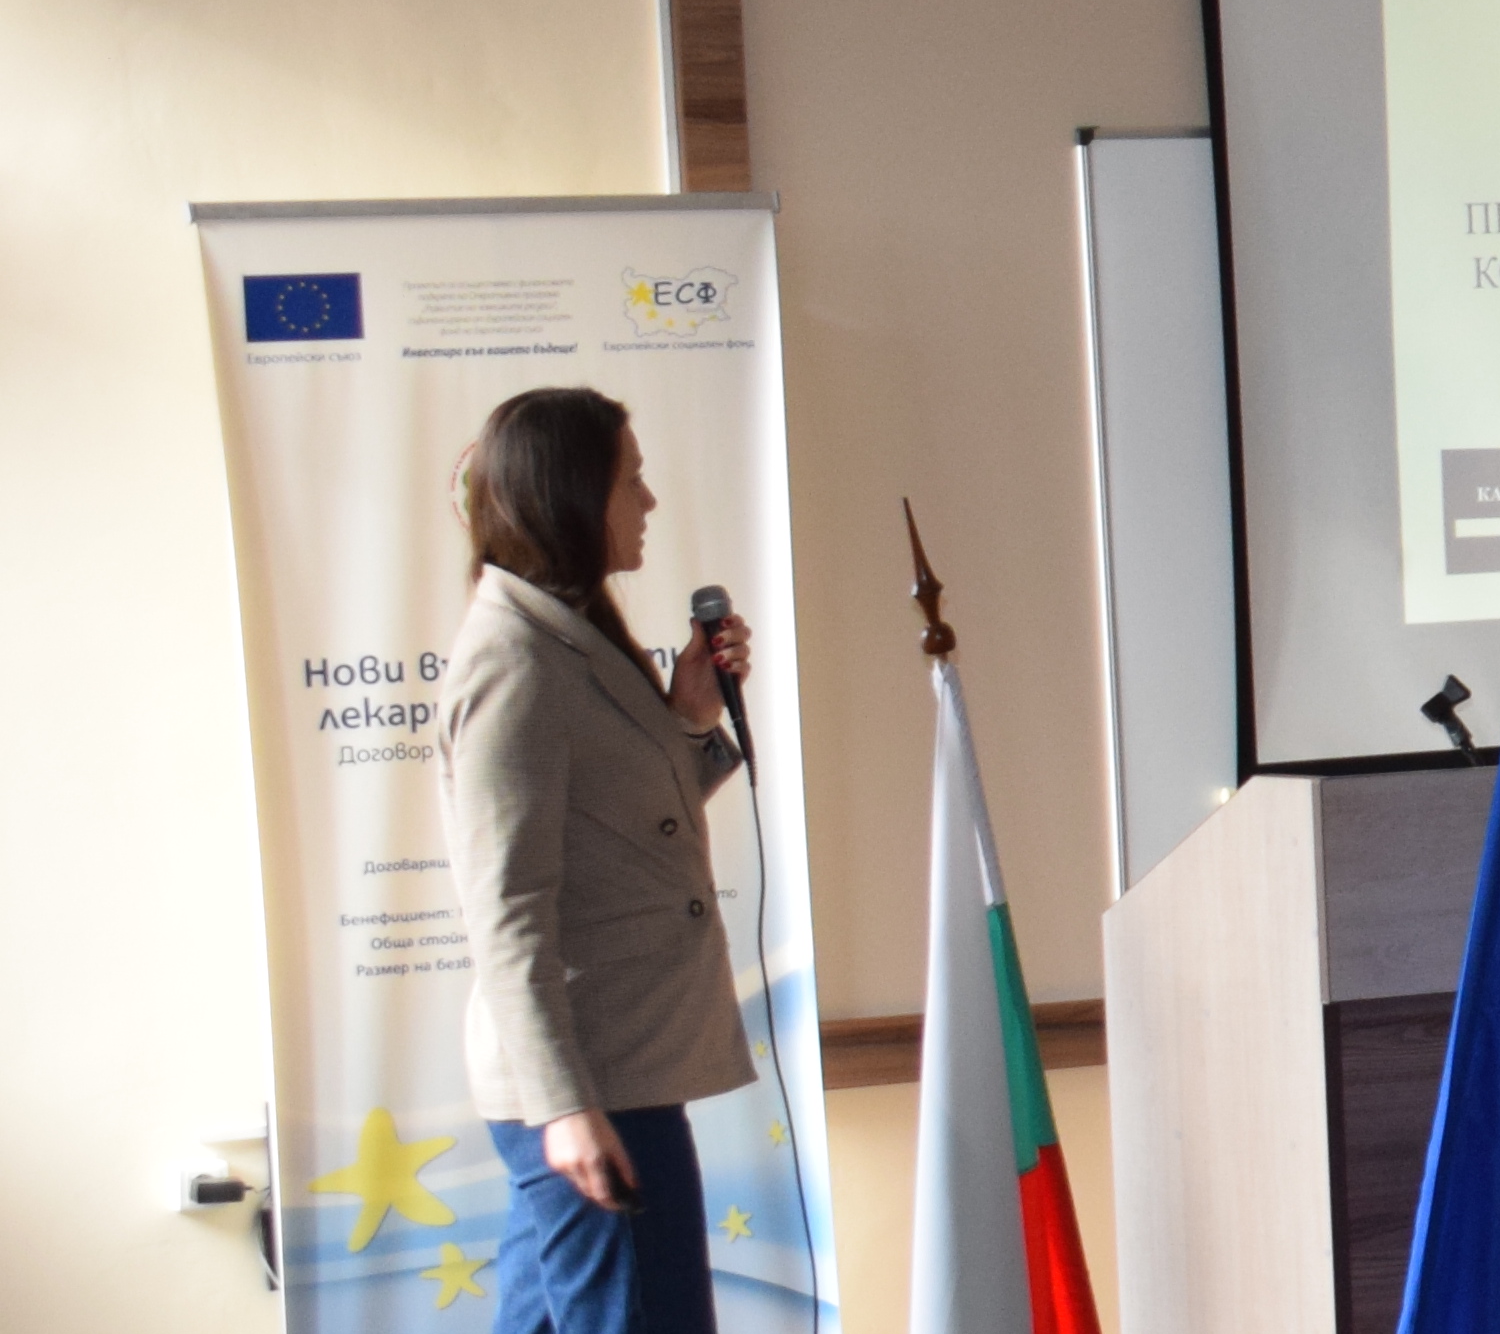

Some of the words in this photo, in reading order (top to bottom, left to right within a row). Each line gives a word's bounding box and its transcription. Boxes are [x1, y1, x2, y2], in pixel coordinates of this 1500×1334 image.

[654, 281, 717, 305] ЕСФ
[304, 655, 406, 687] Нови
[339, 742, 434, 766] Договор
[357, 963, 410, 977] Размер
[414, 962, 431, 972] на
